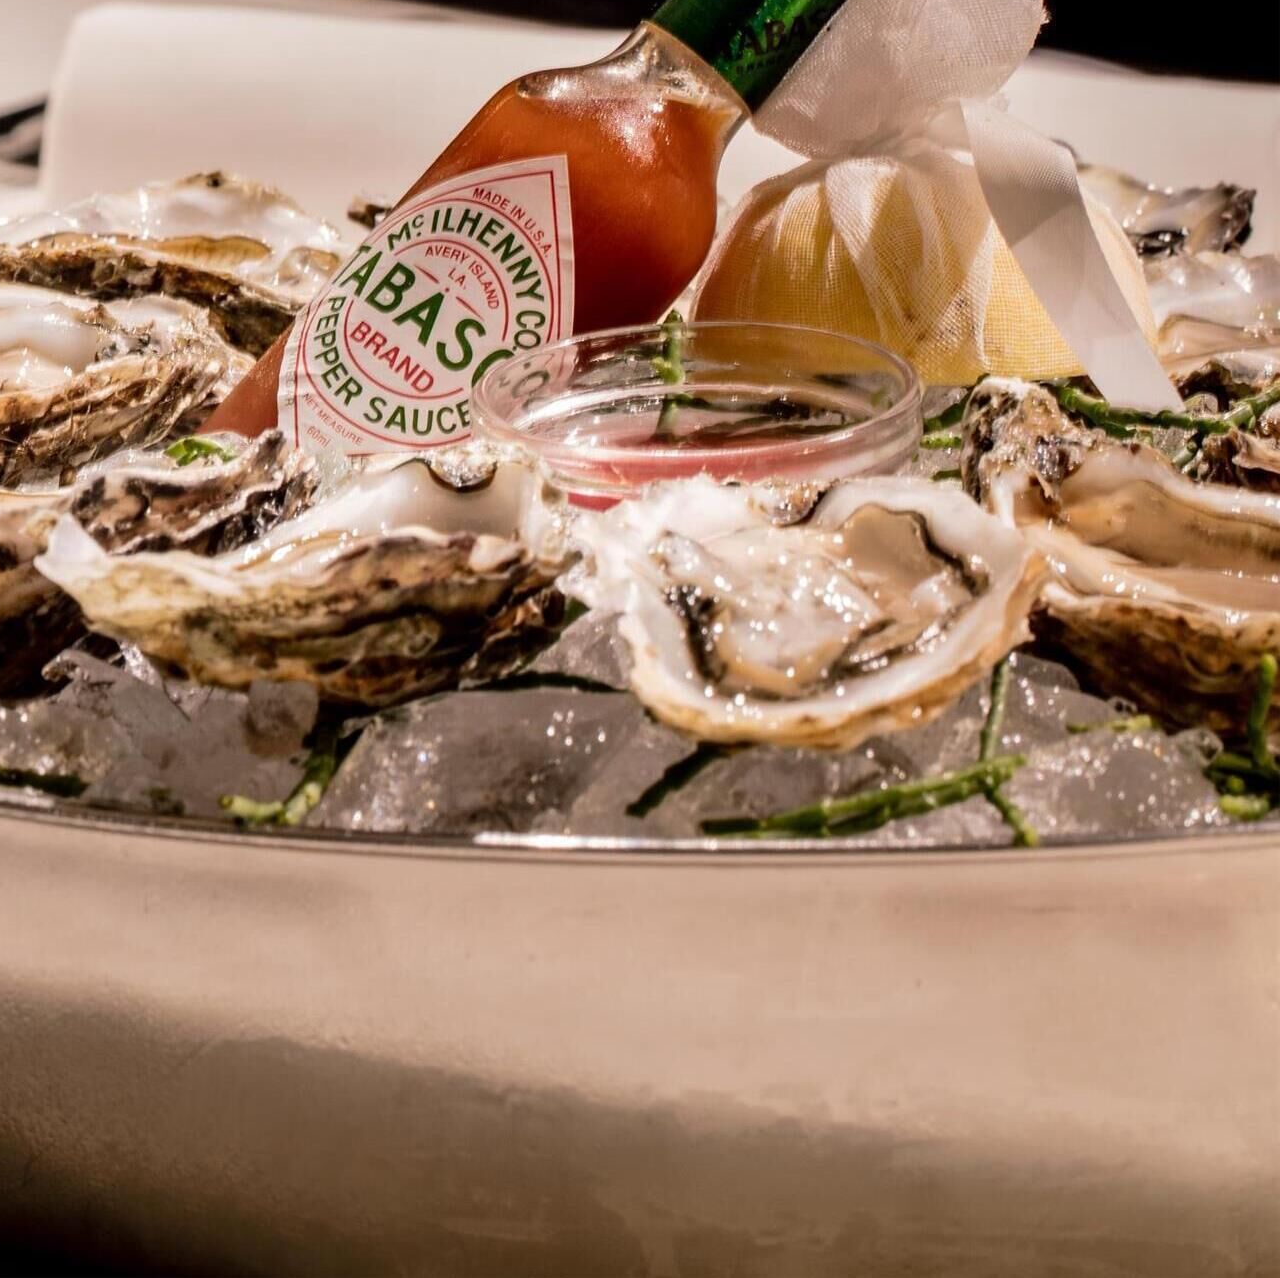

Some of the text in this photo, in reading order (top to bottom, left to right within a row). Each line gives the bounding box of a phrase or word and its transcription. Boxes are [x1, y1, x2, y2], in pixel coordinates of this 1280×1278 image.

[472, 187, 553, 258] MADE IN U.S.A.
[425, 245, 500, 310] AVERY ISLAND
[447, 267, 467, 290] LA.
[332, 245, 517, 388] TABASC
[513, 310, 546, 351] CO.
[313, 296, 364, 407] PEPPER
[363, 396, 471, 436] SAUCE
[349, 321, 435, 393] BRAND
[303, 393, 363, 446] NET MEASURE
